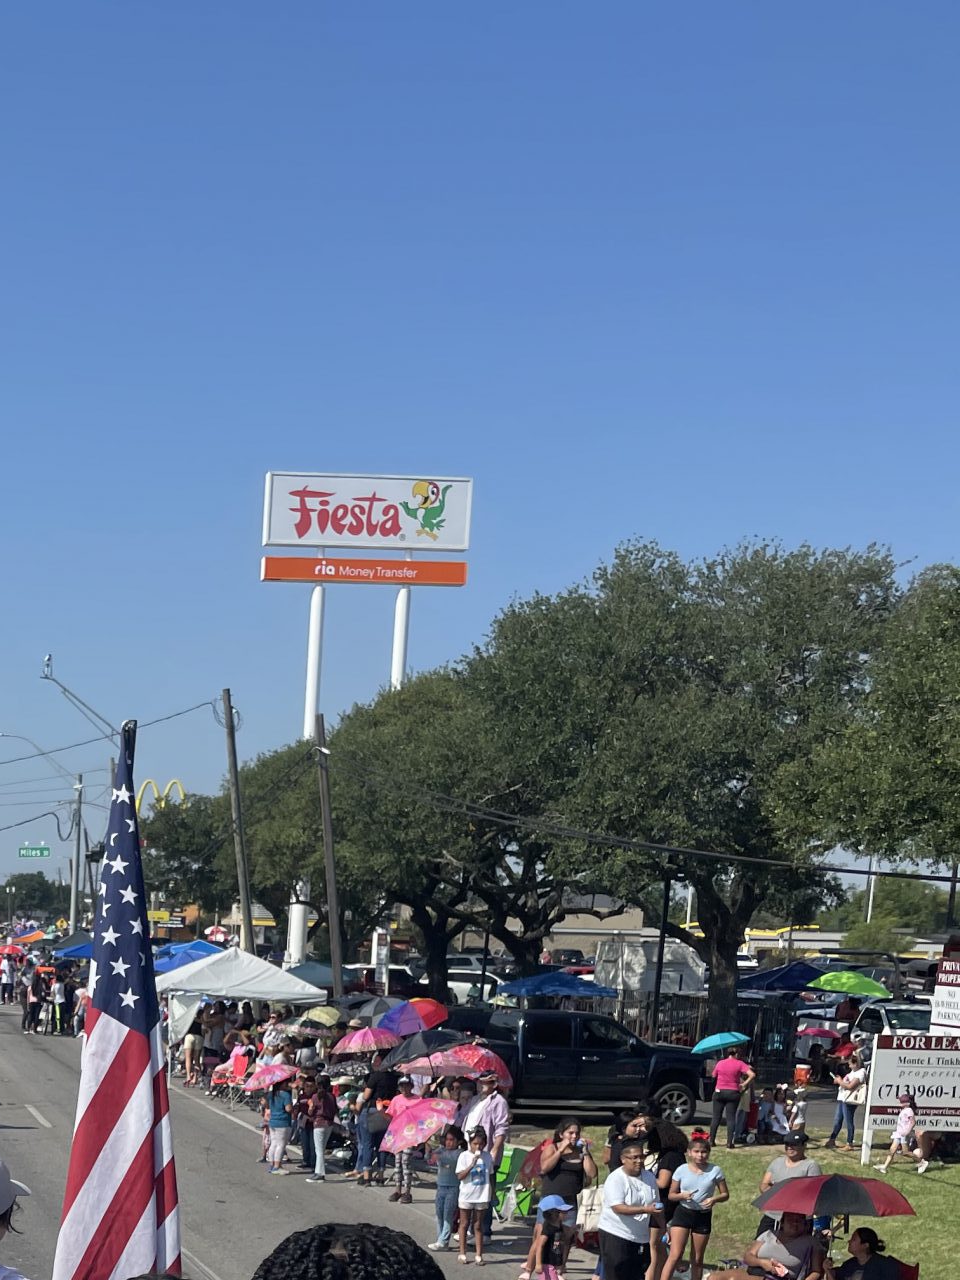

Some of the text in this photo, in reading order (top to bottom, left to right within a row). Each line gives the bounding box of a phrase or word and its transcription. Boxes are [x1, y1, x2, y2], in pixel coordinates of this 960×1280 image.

[288, 485, 402, 539] Fiesta
[314, 560, 418, 579] ria Money Transfer
[20, 849, 40, 857] Miles
[891, 1036, 926, 1049] FOR
[897, 1056, 925, 1065] Monte
